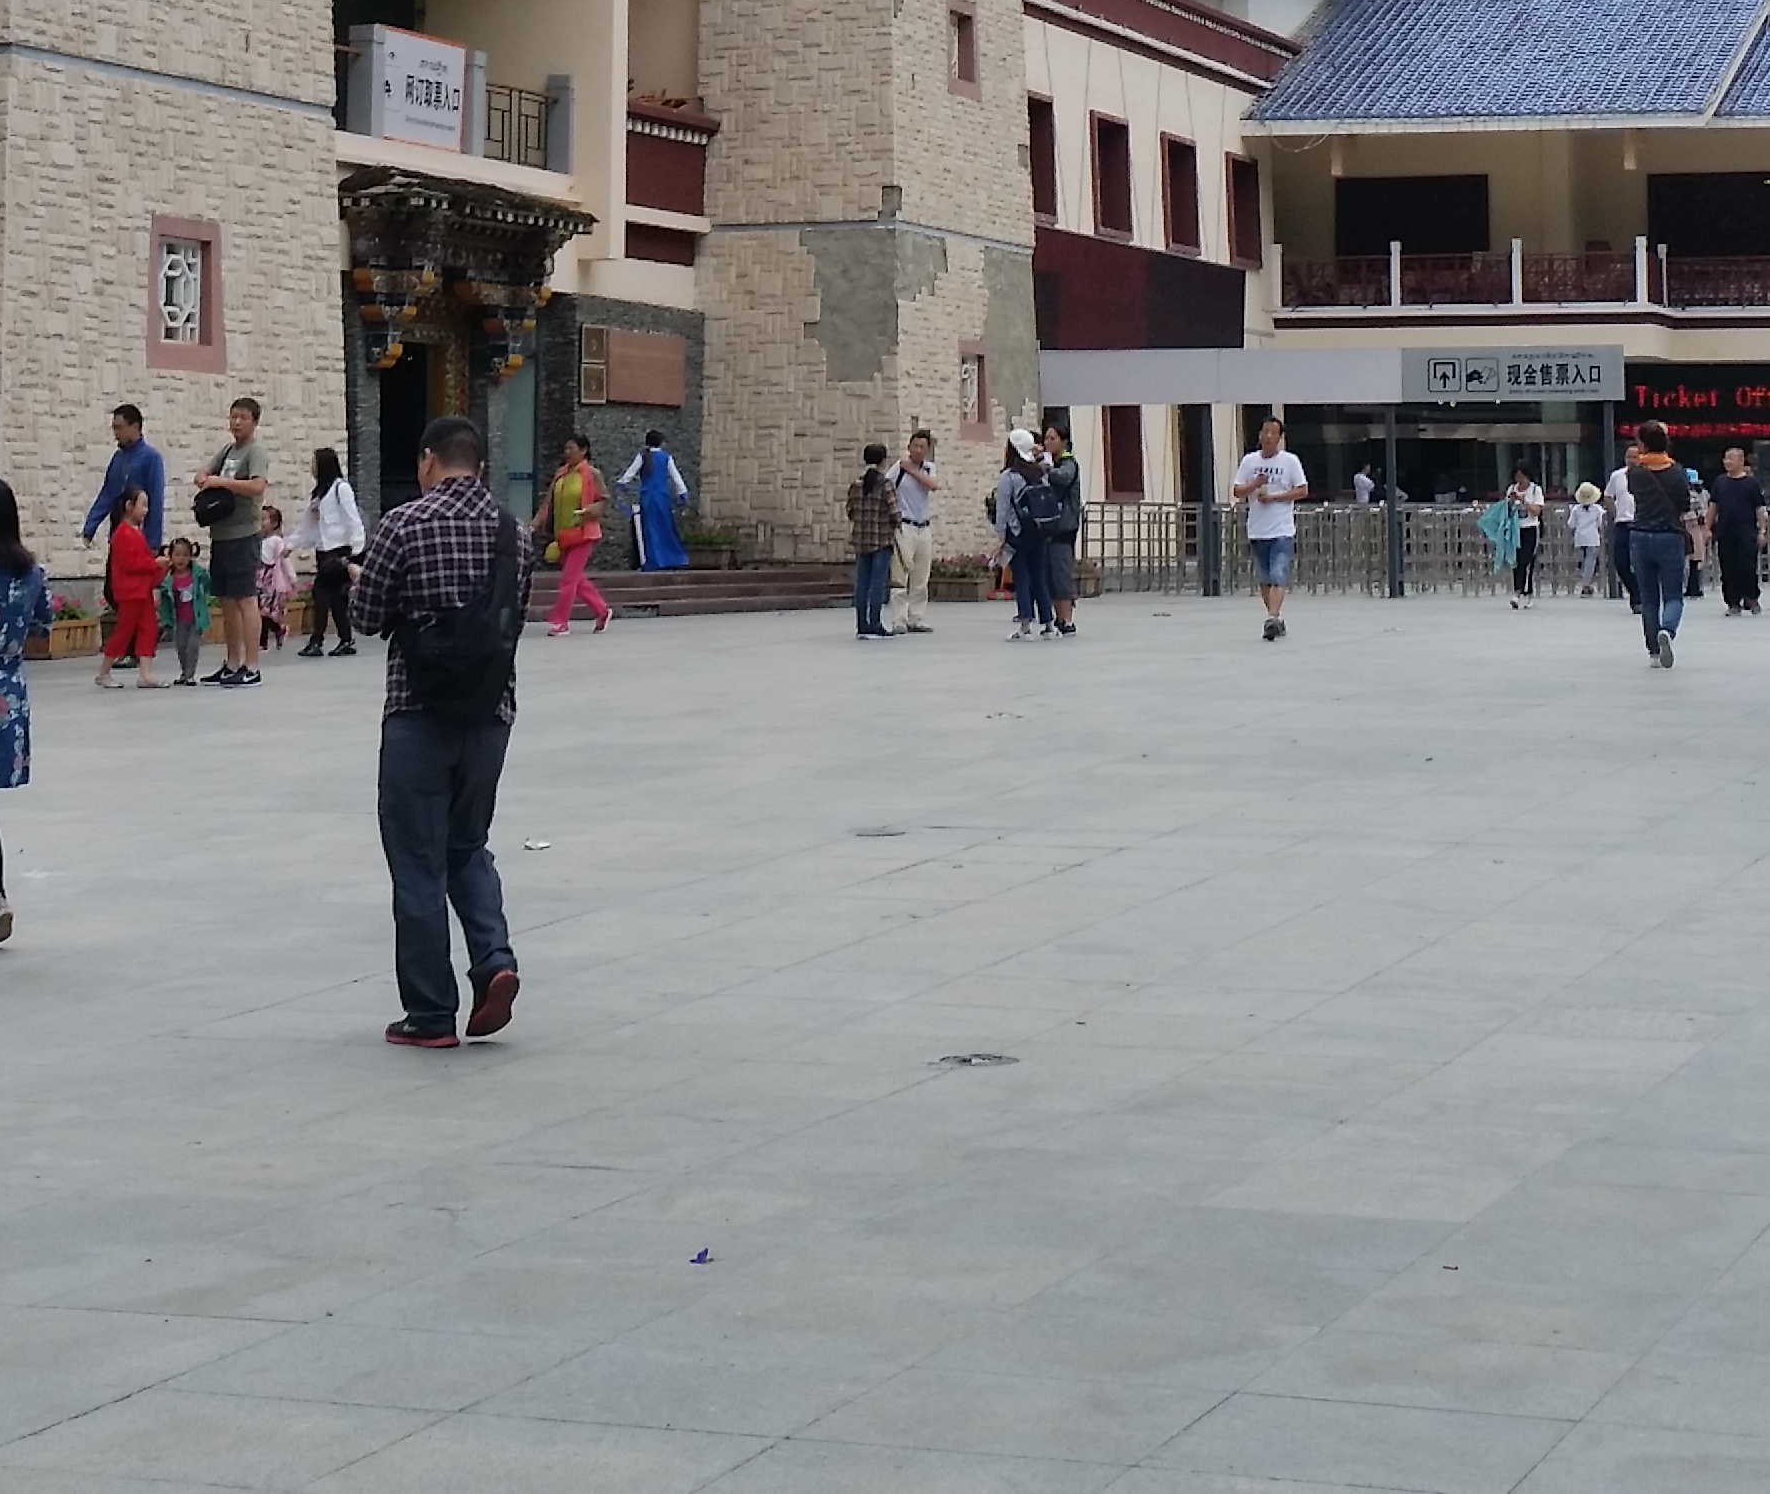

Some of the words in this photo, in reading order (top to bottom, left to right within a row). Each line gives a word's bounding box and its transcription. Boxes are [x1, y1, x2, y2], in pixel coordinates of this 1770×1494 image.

[1507, 363, 1602, 386] 现金售票入口
[1635, 385, 1718, 408] Ticket
